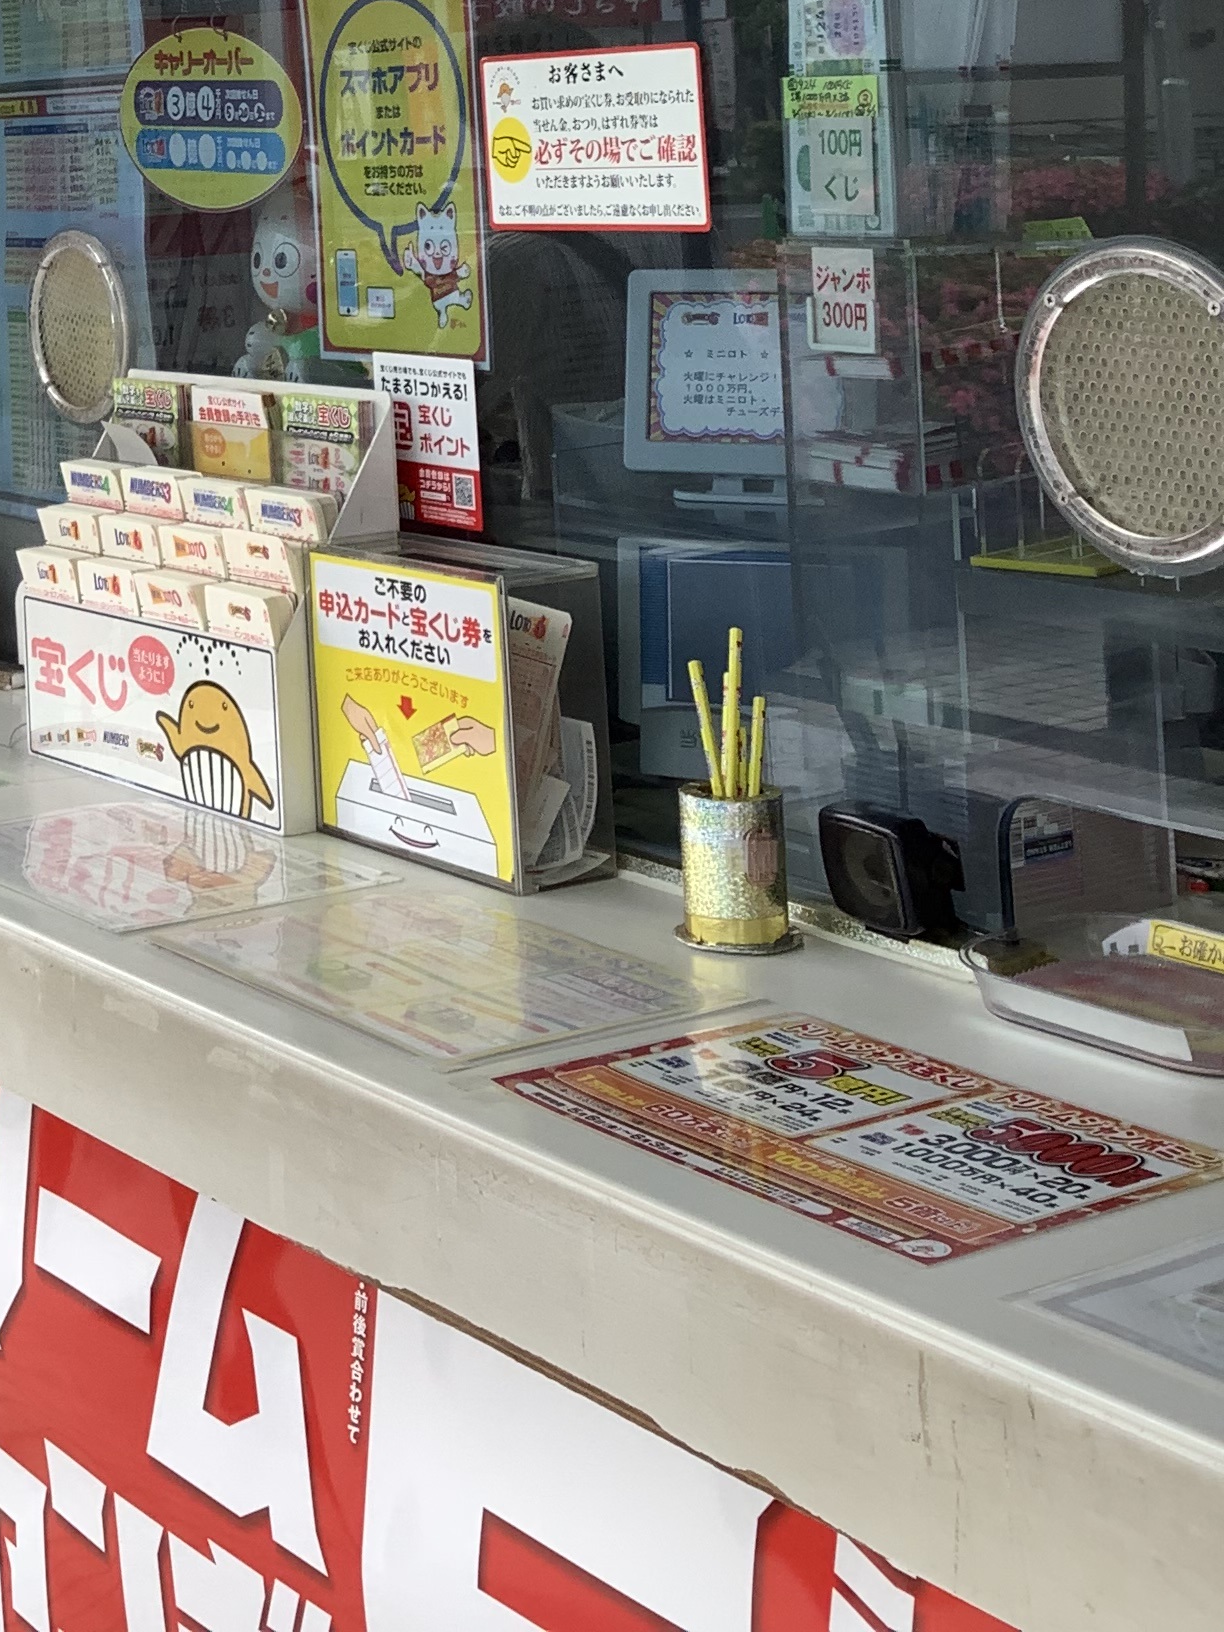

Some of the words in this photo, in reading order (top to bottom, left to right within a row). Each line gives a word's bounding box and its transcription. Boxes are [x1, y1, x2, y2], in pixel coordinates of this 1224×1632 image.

[154, 47, 254, 76] キャリーオーバー
[548, 61, 624, 84] お客さまへ
[340, 62, 439, 97] スマホアプリ
[375, 106, 401, 119] または
[340, 125, 446, 156] ポイントカード
[534, 134, 697, 165] 必ずその場でご確認
[819, 129, 863, 156] 100円
[363, 165, 423, 179] をお持ちの方は
[536, 173, 678, 189] いただきますようお願いいたします。
[824, 175, 859, 203] くじ
[816, 265, 871, 294] ジャンボ
[822, 301, 868, 332] 300円
[706, 350, 748, 358] ミニロト
[144, 387, 172, 411] 宝くじ
[199, 406, 261, 426] 会員登録の手引き
[317, 403, 350, 428] 宝くじ
[418, 404, 452, 427] 宝くじ
[420, 433, 470, 458] ポイント
[374, 575, 427, 603] ご不要の
[318, 589, 492, 649] 申込カードと宝くじ券を
[132, 648, 170, 669] 当たります
[358, 628, 451, 665] お入れください
[31, 637, 128, 712] 宝くじ
[345, 667, 470, 709] ご来店ありがとうございます
